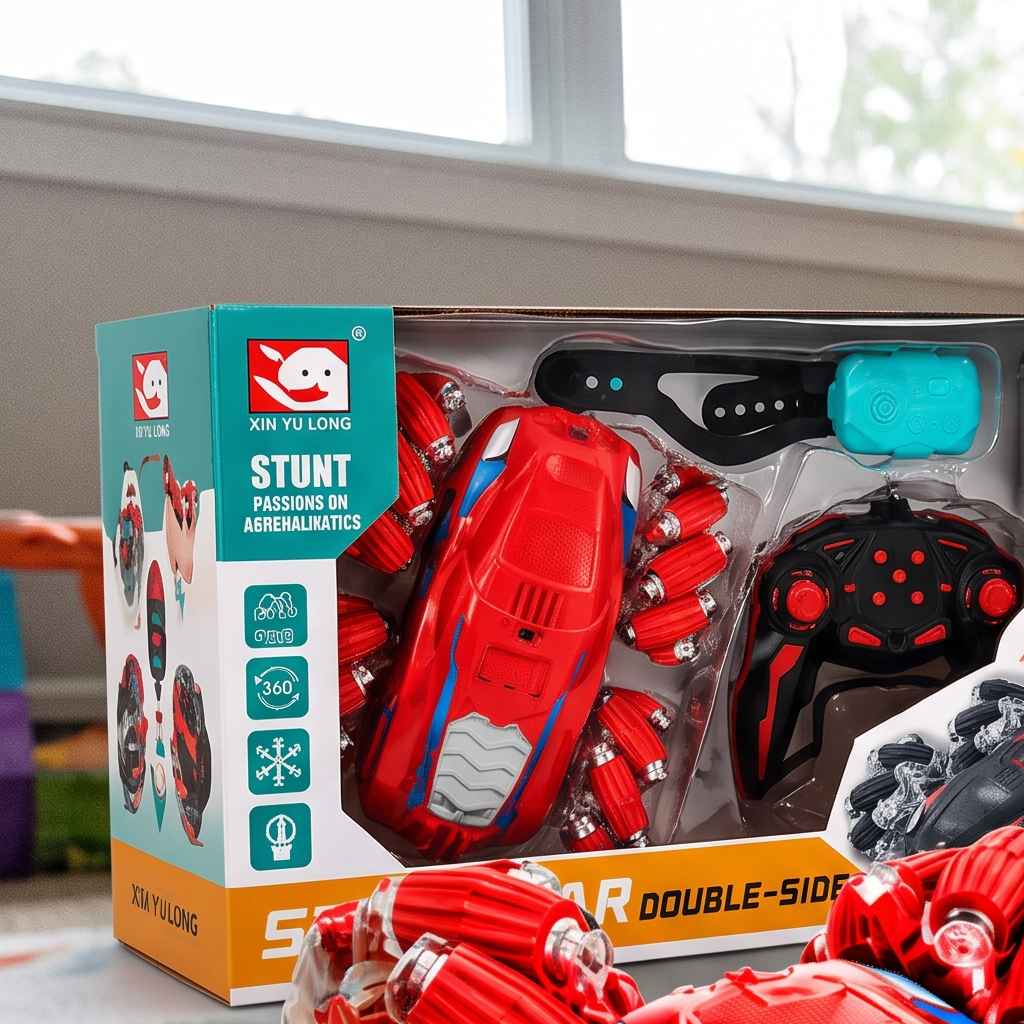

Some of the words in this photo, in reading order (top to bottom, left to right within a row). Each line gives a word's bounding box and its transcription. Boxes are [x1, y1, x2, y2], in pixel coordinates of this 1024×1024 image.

[249, 417, 277, 431] XIN
[282, 417, 303, 431] YU
[308, 416, 352, 430] LONG
[251, 453, 351, 489] STUNT
[253, 495, 324, 512] PASSIONS
[328, 494, 348, 510] ON
[262, 681, 293, 696] 360
